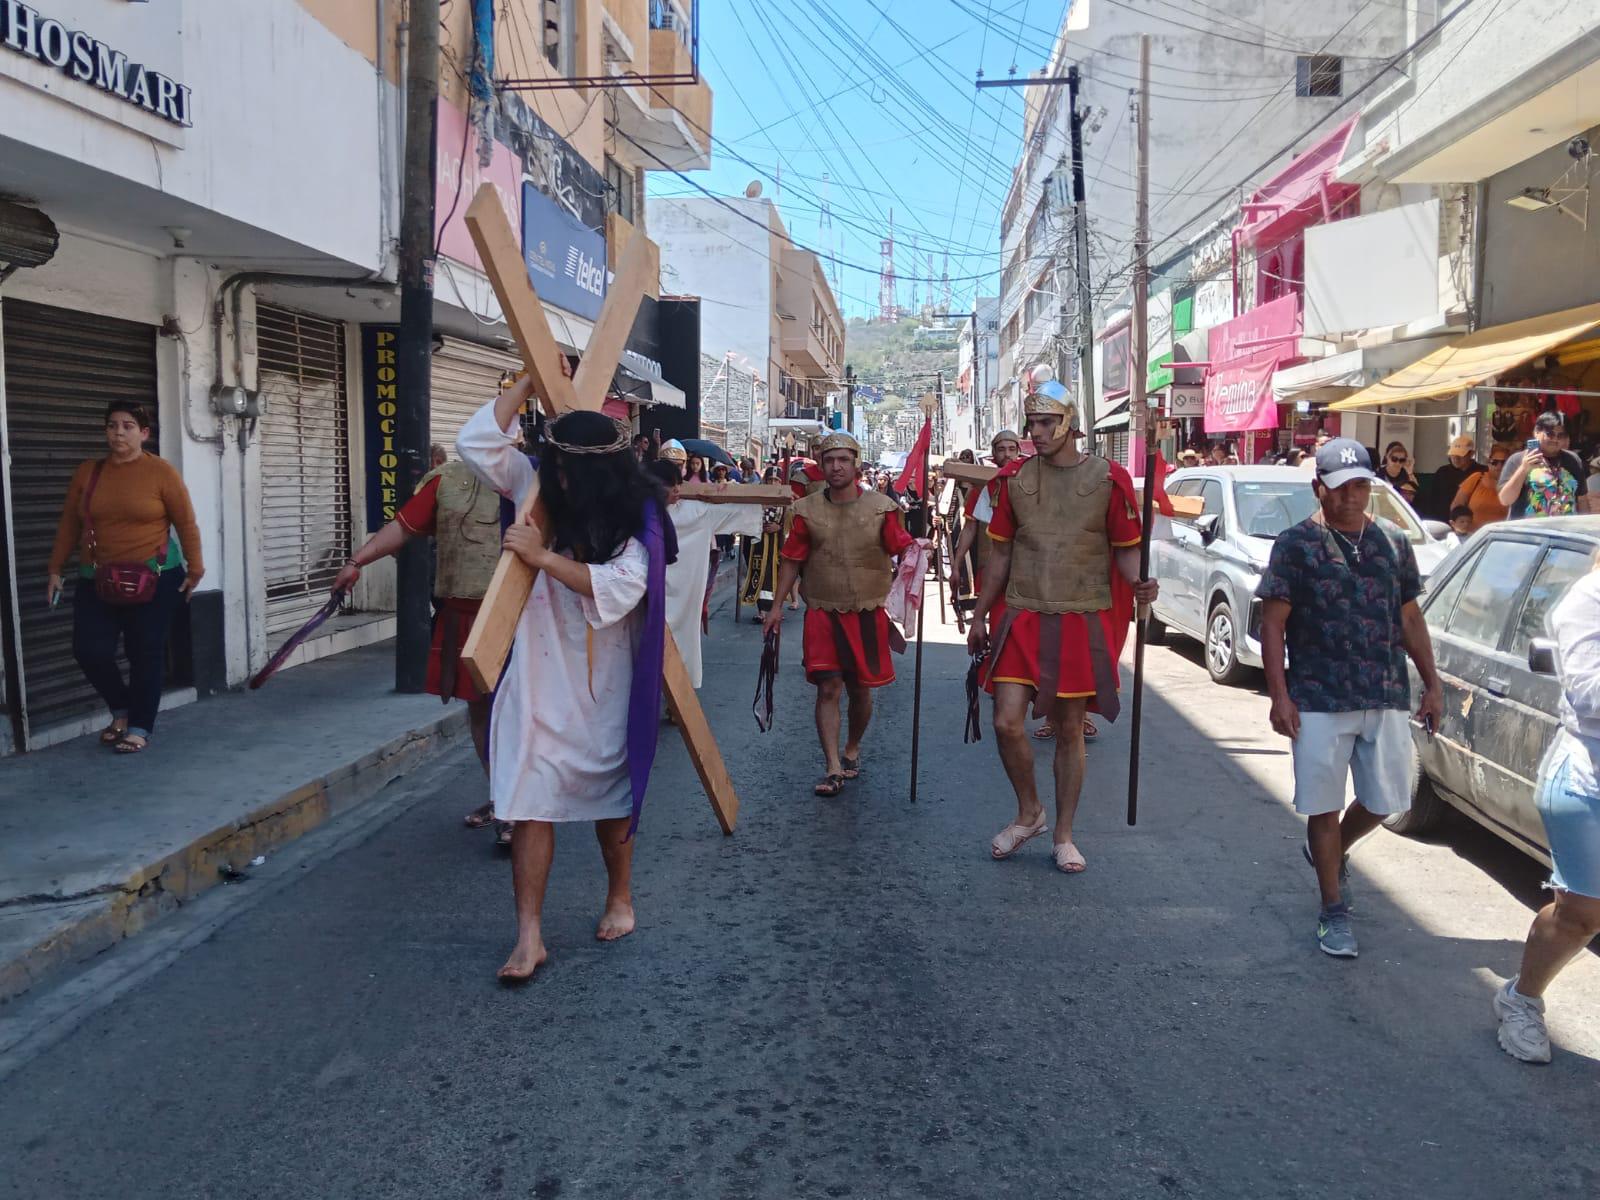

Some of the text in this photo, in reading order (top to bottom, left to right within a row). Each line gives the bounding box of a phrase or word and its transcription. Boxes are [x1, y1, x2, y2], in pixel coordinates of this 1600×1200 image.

[3, 0, 193, 128] HOSMARI
[576, 251, 606, 297] telcel
[376, 331, 398, 520] PROMOCIONES
